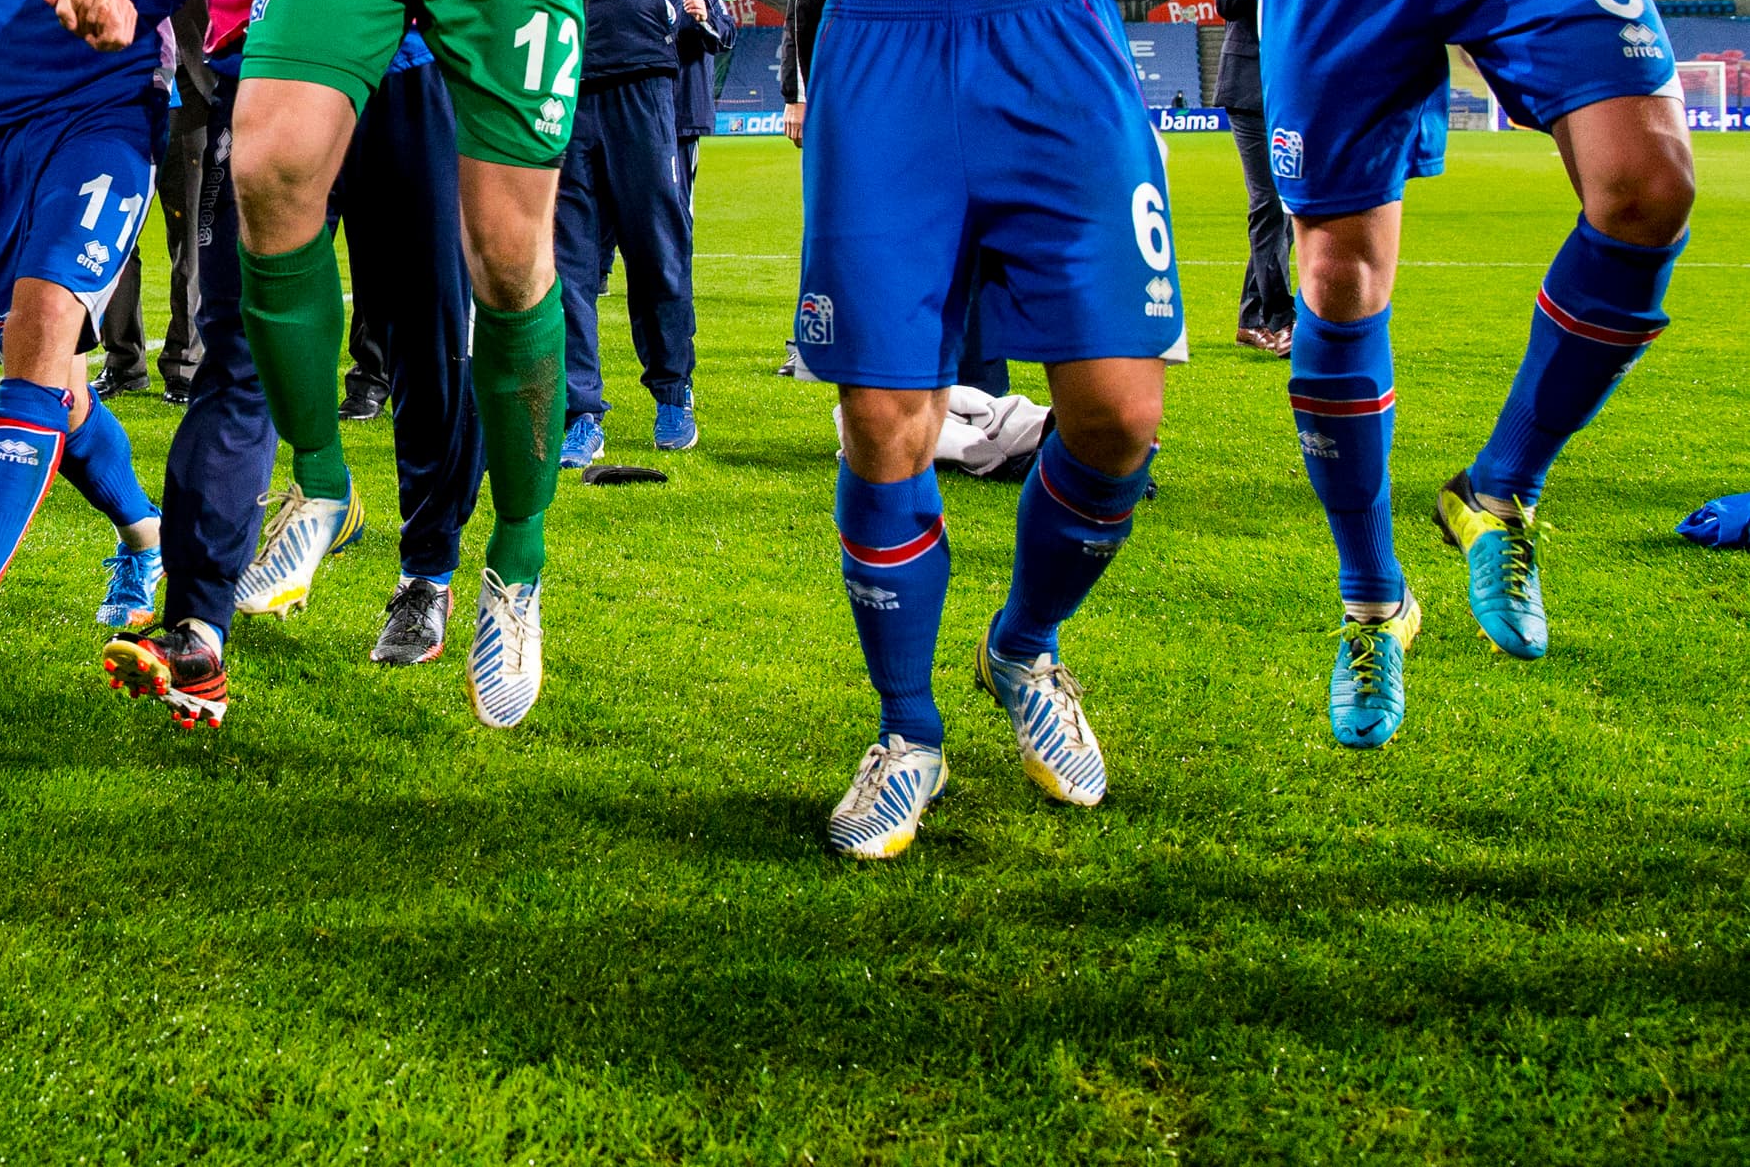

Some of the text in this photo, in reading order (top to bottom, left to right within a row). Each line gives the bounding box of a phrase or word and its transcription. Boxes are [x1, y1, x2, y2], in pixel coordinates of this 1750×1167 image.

[514, 11, 580, 97] 12
[1623, 45, 1664, 60] errea
[535, 118, 562, 136] errea
[79, 173, 144, 253] 11
[1132, 181, 1171, 272] 6
[76, 253, 104, 278] errea
